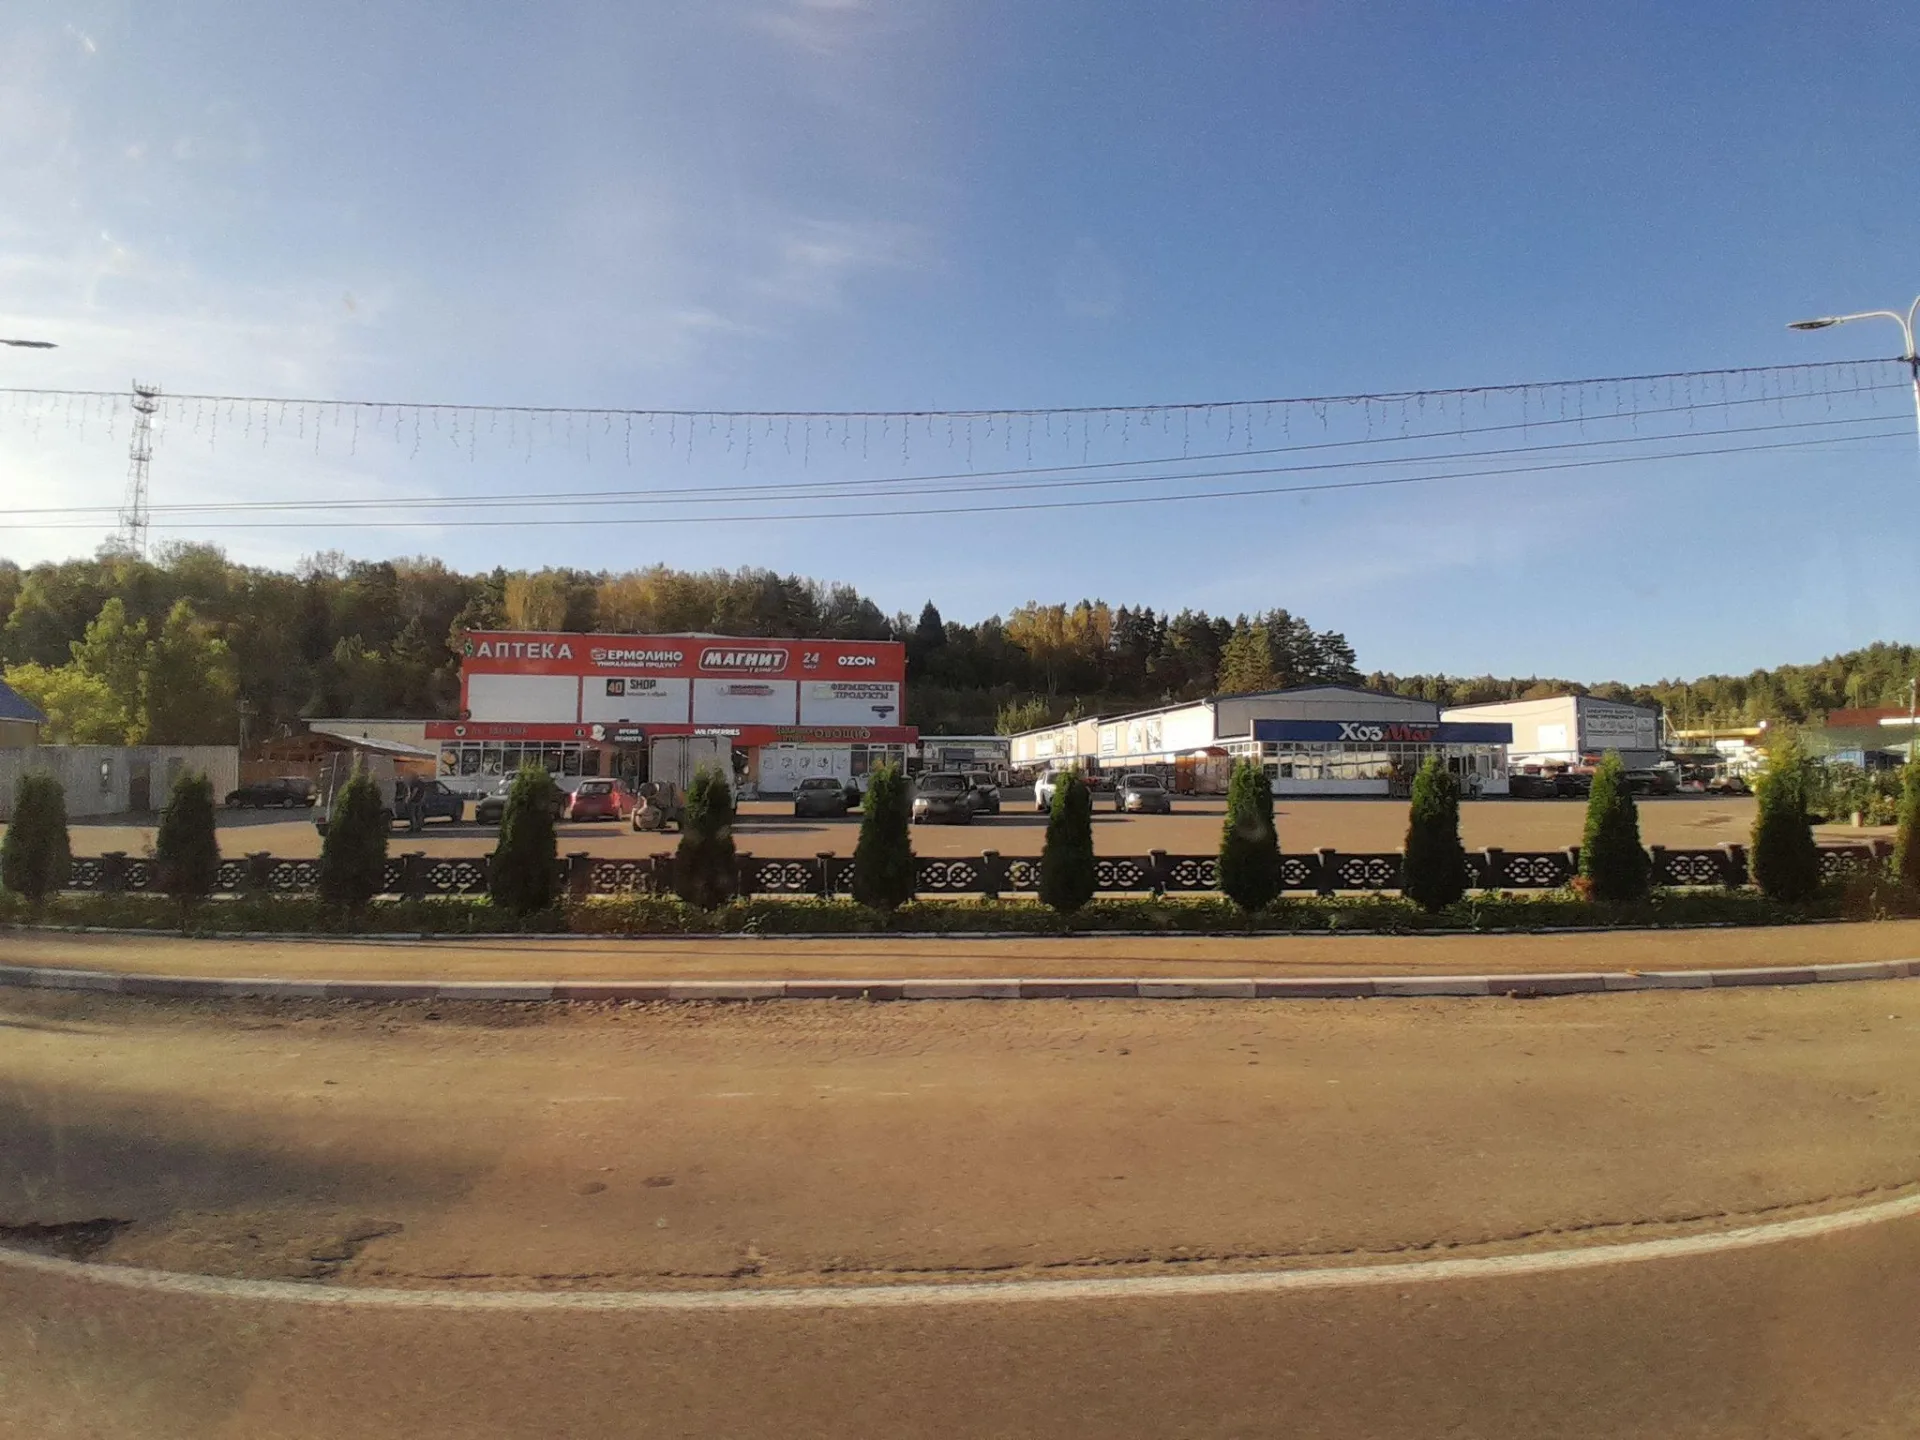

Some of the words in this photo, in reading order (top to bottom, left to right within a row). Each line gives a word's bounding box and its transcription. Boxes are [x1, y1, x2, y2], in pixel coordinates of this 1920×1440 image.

[477, 642, 573, 660] АПТЕКА
[608, 650, 683, 661] ЕРМОЛИНО
[704, 652, 784, 667] МАГНИТ
[802, 652, 819, 663] 24
[837, 656, 876, 666] OZON
[630, 679, 656, 690] SHOP
[831, 683, 895, 692] ФЕРМЕРСКИЕ
[834, 691, 889, 700] ПРОДУКТЫ
